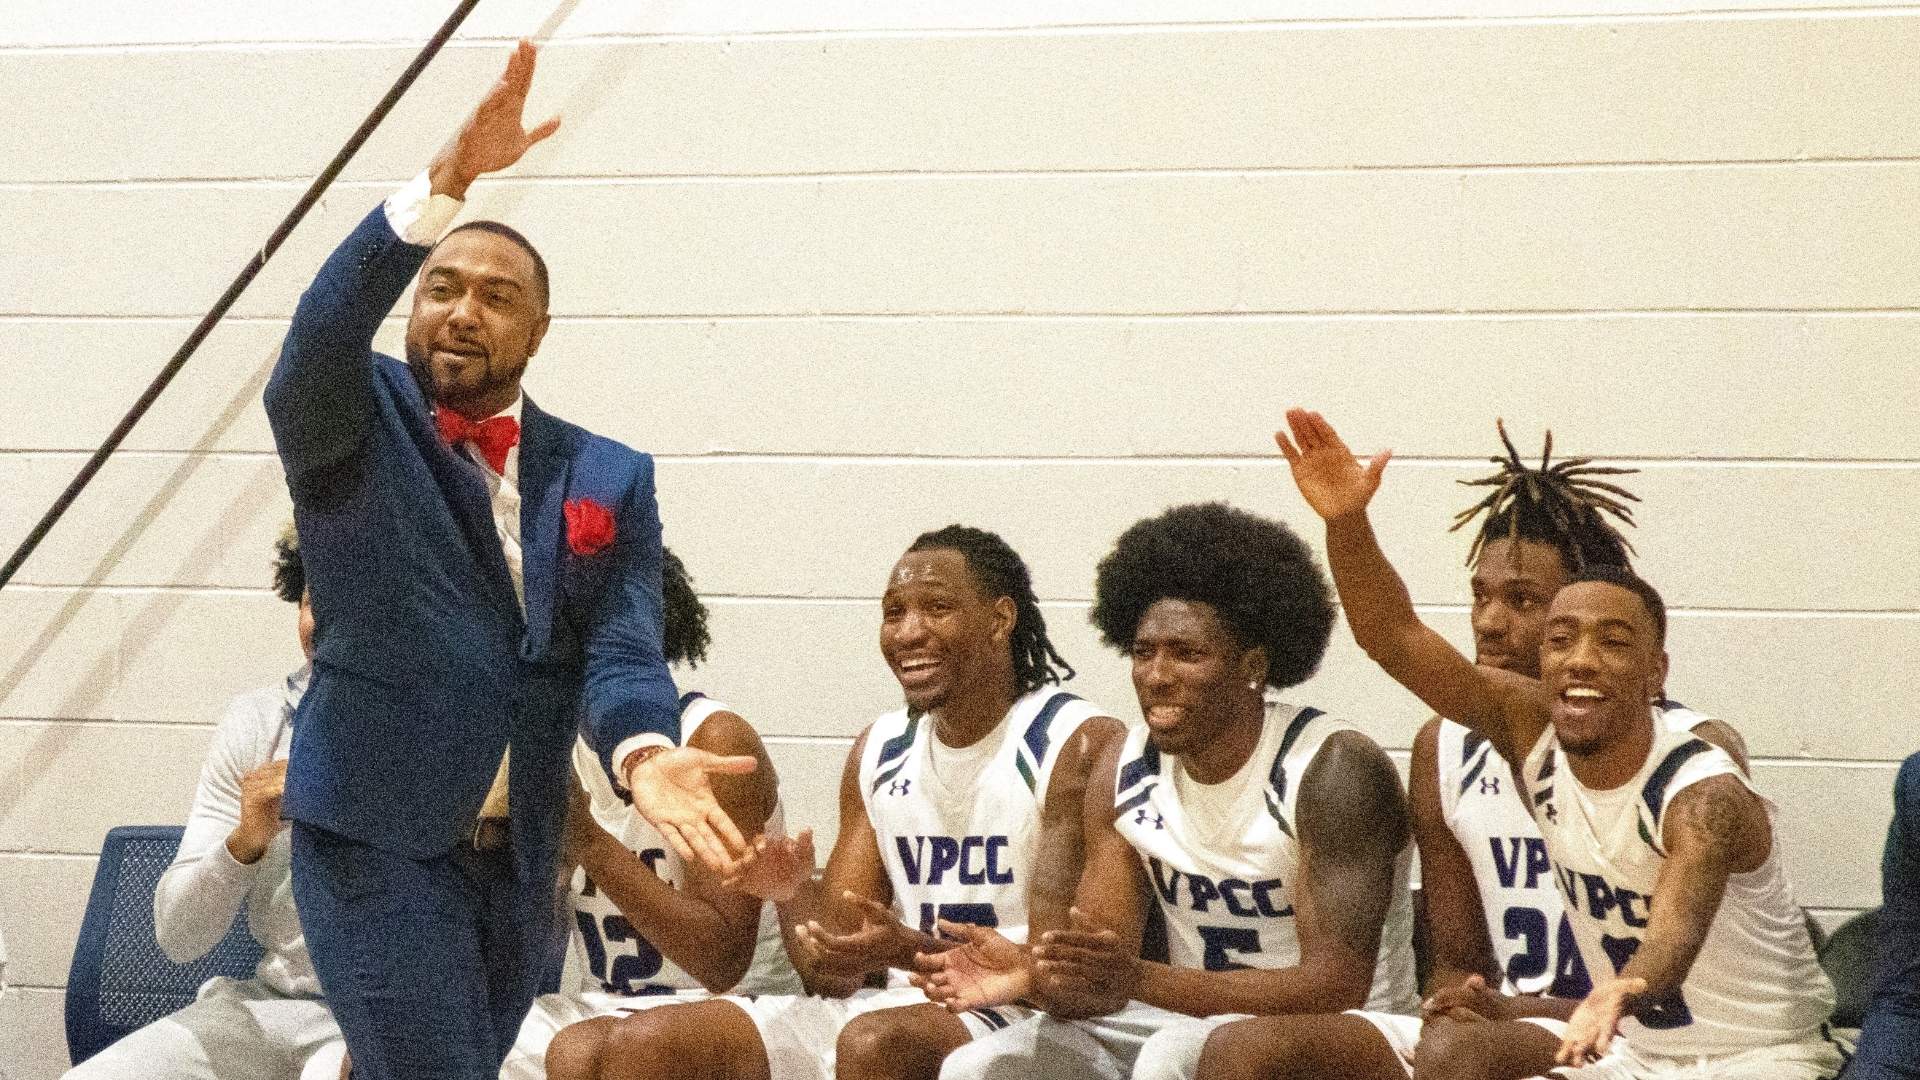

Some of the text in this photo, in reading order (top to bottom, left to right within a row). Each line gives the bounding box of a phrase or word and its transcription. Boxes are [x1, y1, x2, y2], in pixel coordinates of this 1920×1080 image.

[895, 835, 1015, 885] VPCC
[1148, 856, 1295, 918] VPCC
[1489, 837, 1551, 889] VP
[1554, 860, 1653, 928] VPC
[576, 910, 677, 997] 12
